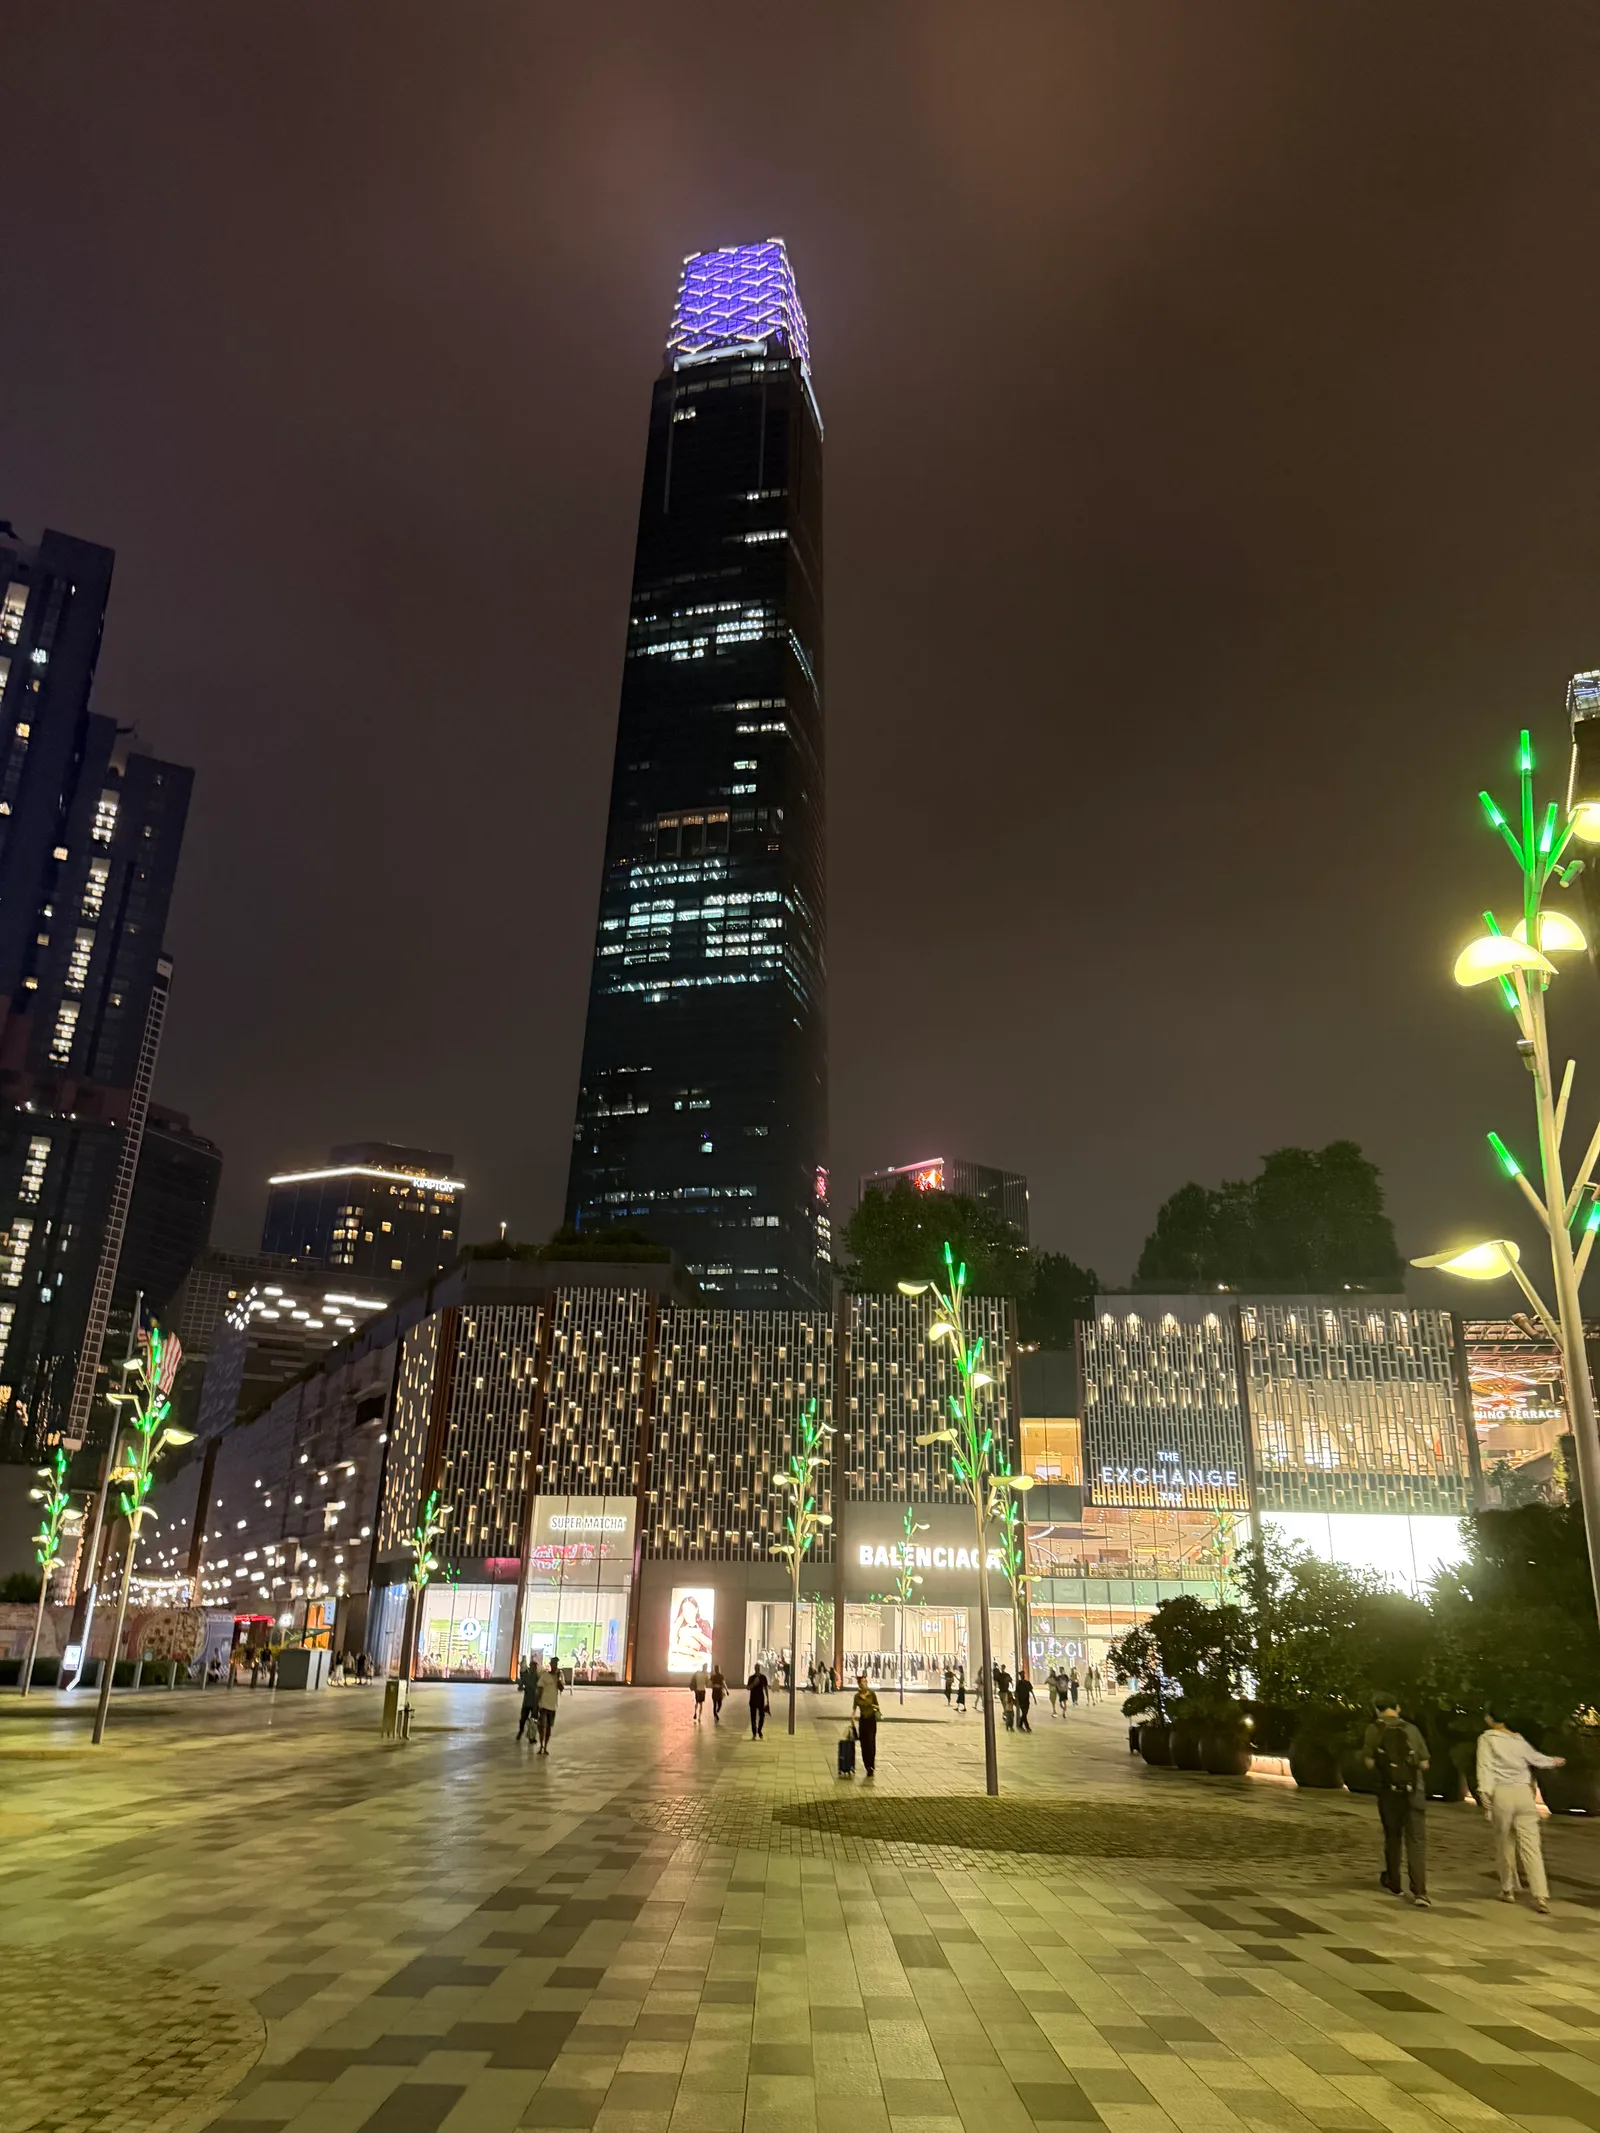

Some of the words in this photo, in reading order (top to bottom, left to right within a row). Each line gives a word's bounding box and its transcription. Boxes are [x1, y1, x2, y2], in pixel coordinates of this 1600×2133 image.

[413, 1178, 454, 1193] KIMPTON
[1508, 1409, 1562, 1419] TERRACE
[1157, 1451, 1180, 1462] THE
[1102, 1466, 1238, 1488] EXCHANGE
[1160, 1492, 1182, 1503] TRX
[550, 1516, 582, 1529] SUPER
[584, 1516, 625, 1530] MATCHA
[1028, 1640, 1083, 1658] UCCI
